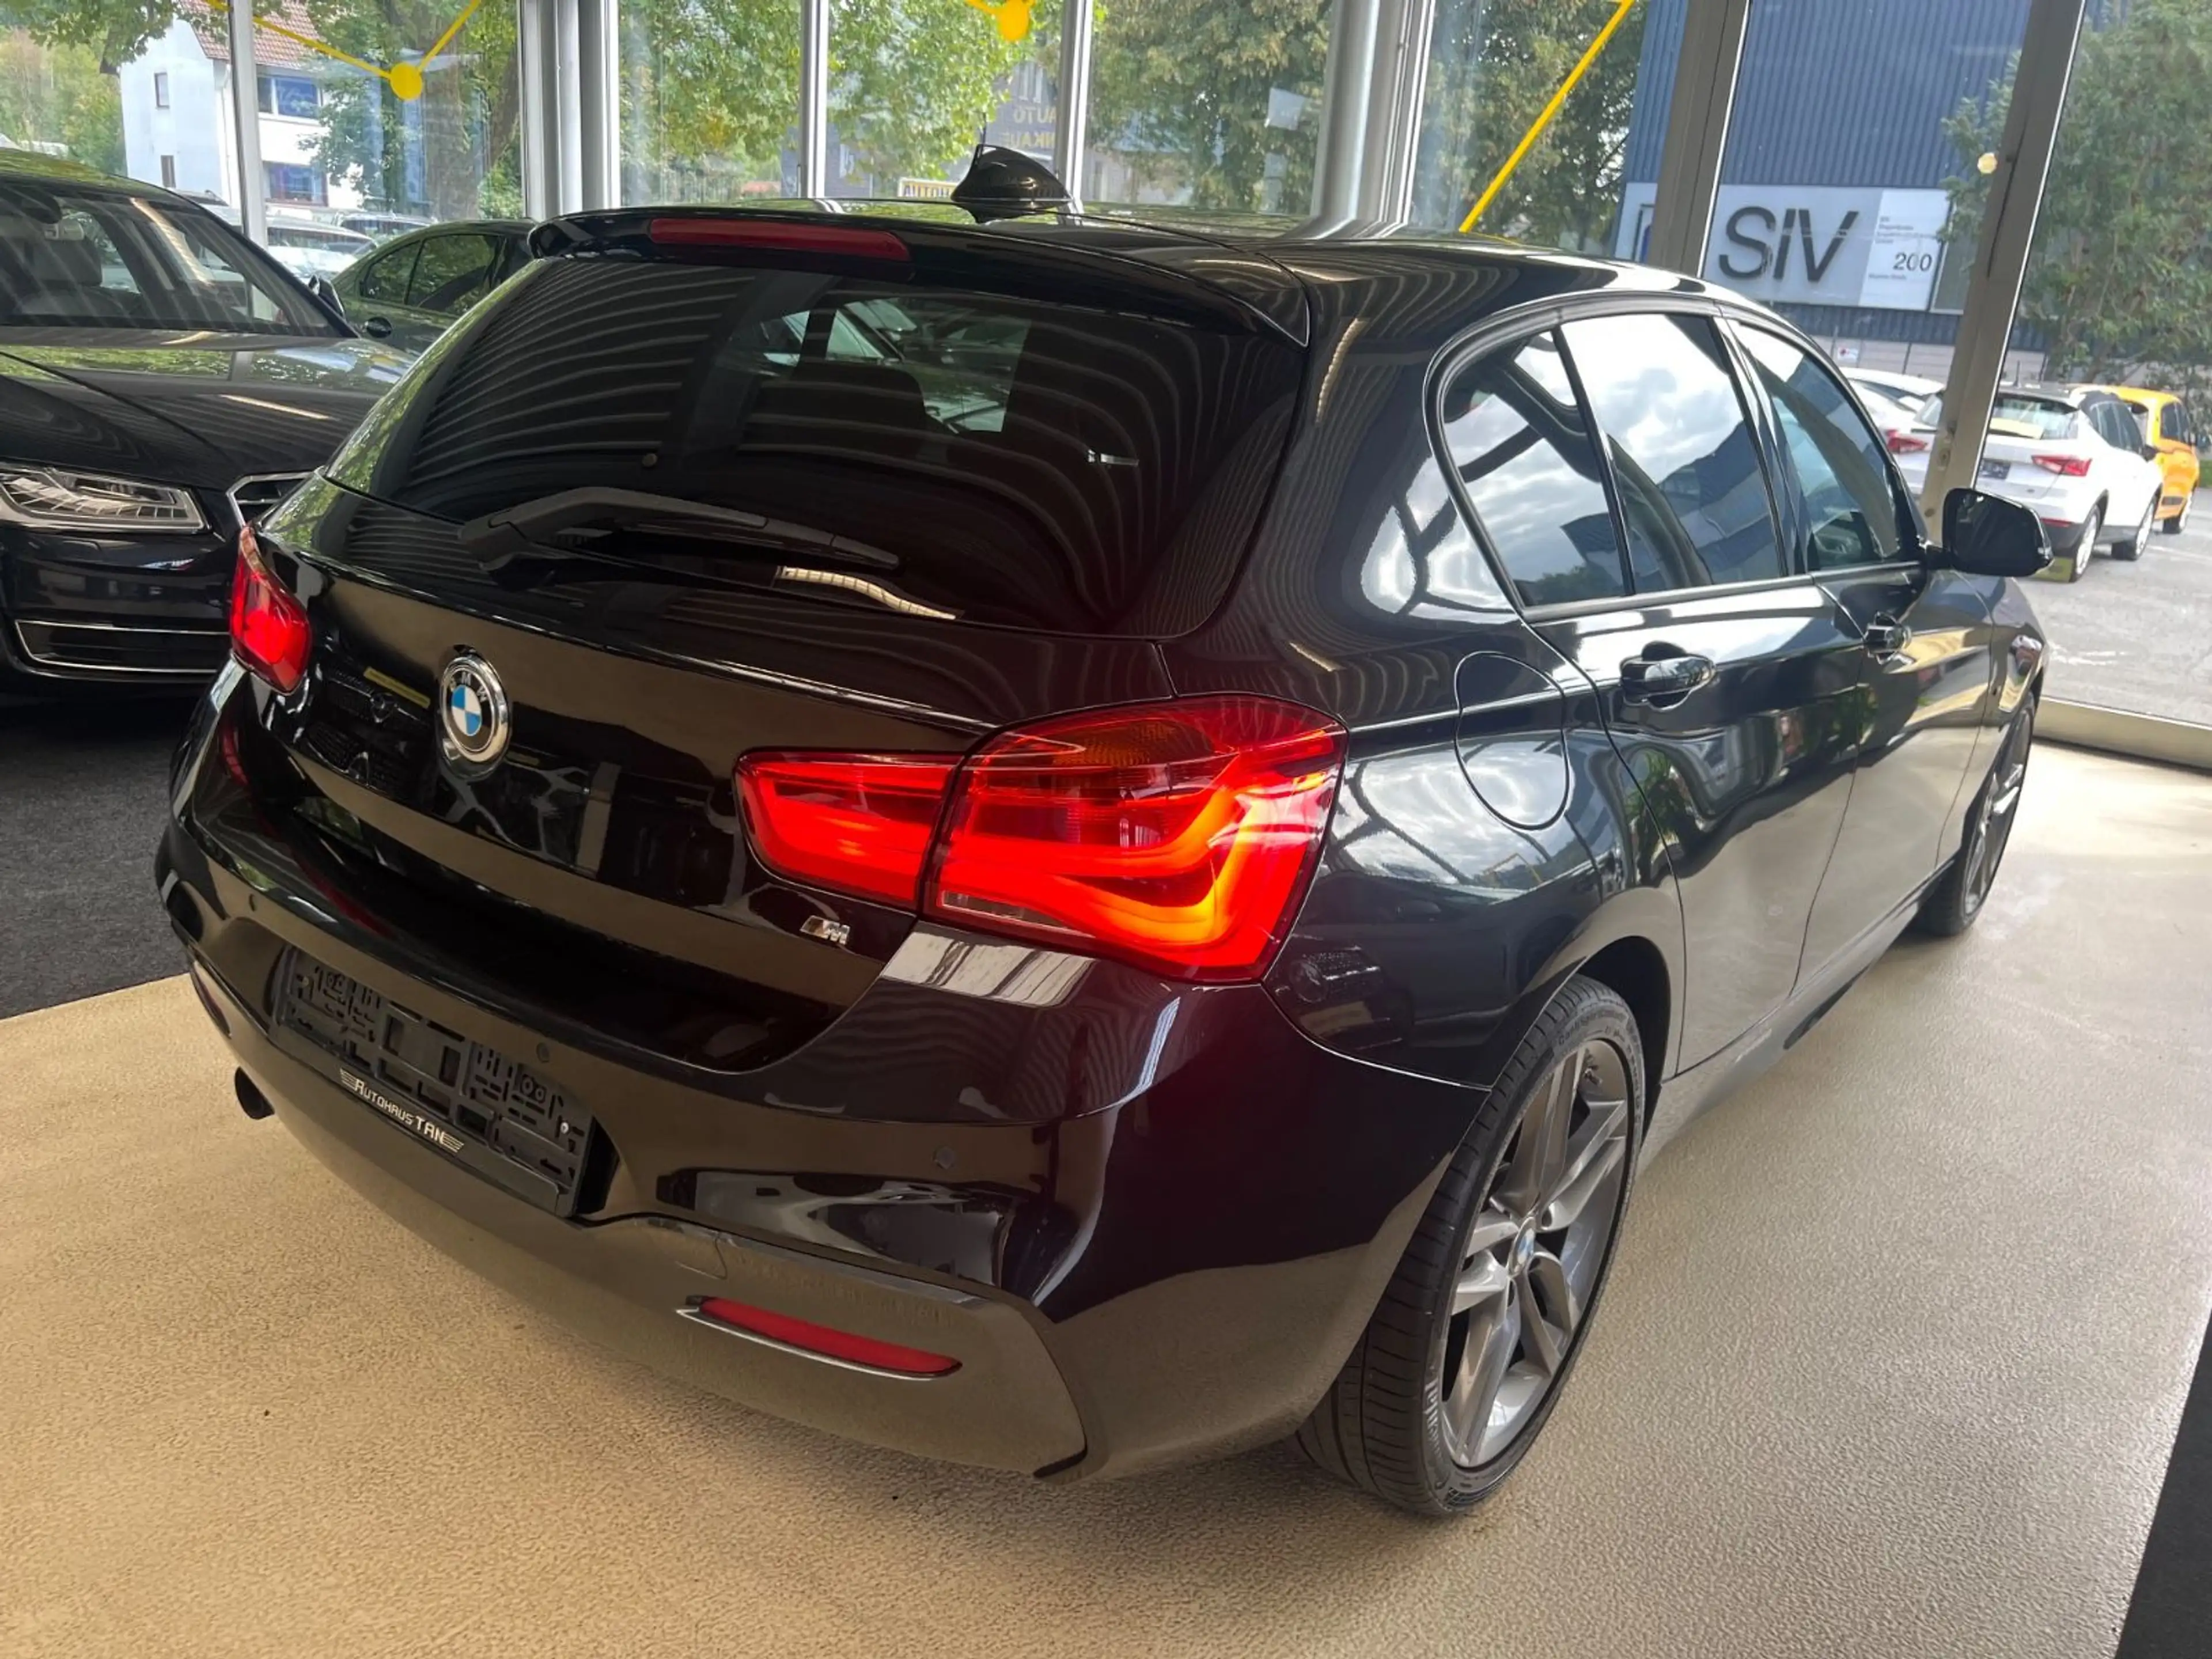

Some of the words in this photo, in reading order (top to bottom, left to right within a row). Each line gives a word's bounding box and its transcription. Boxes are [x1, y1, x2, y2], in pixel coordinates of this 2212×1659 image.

[1893, 252, 1933, 272] 200
[449, 671, 488, 703] BMW
[416, 1115, 446, 1144] TAN
